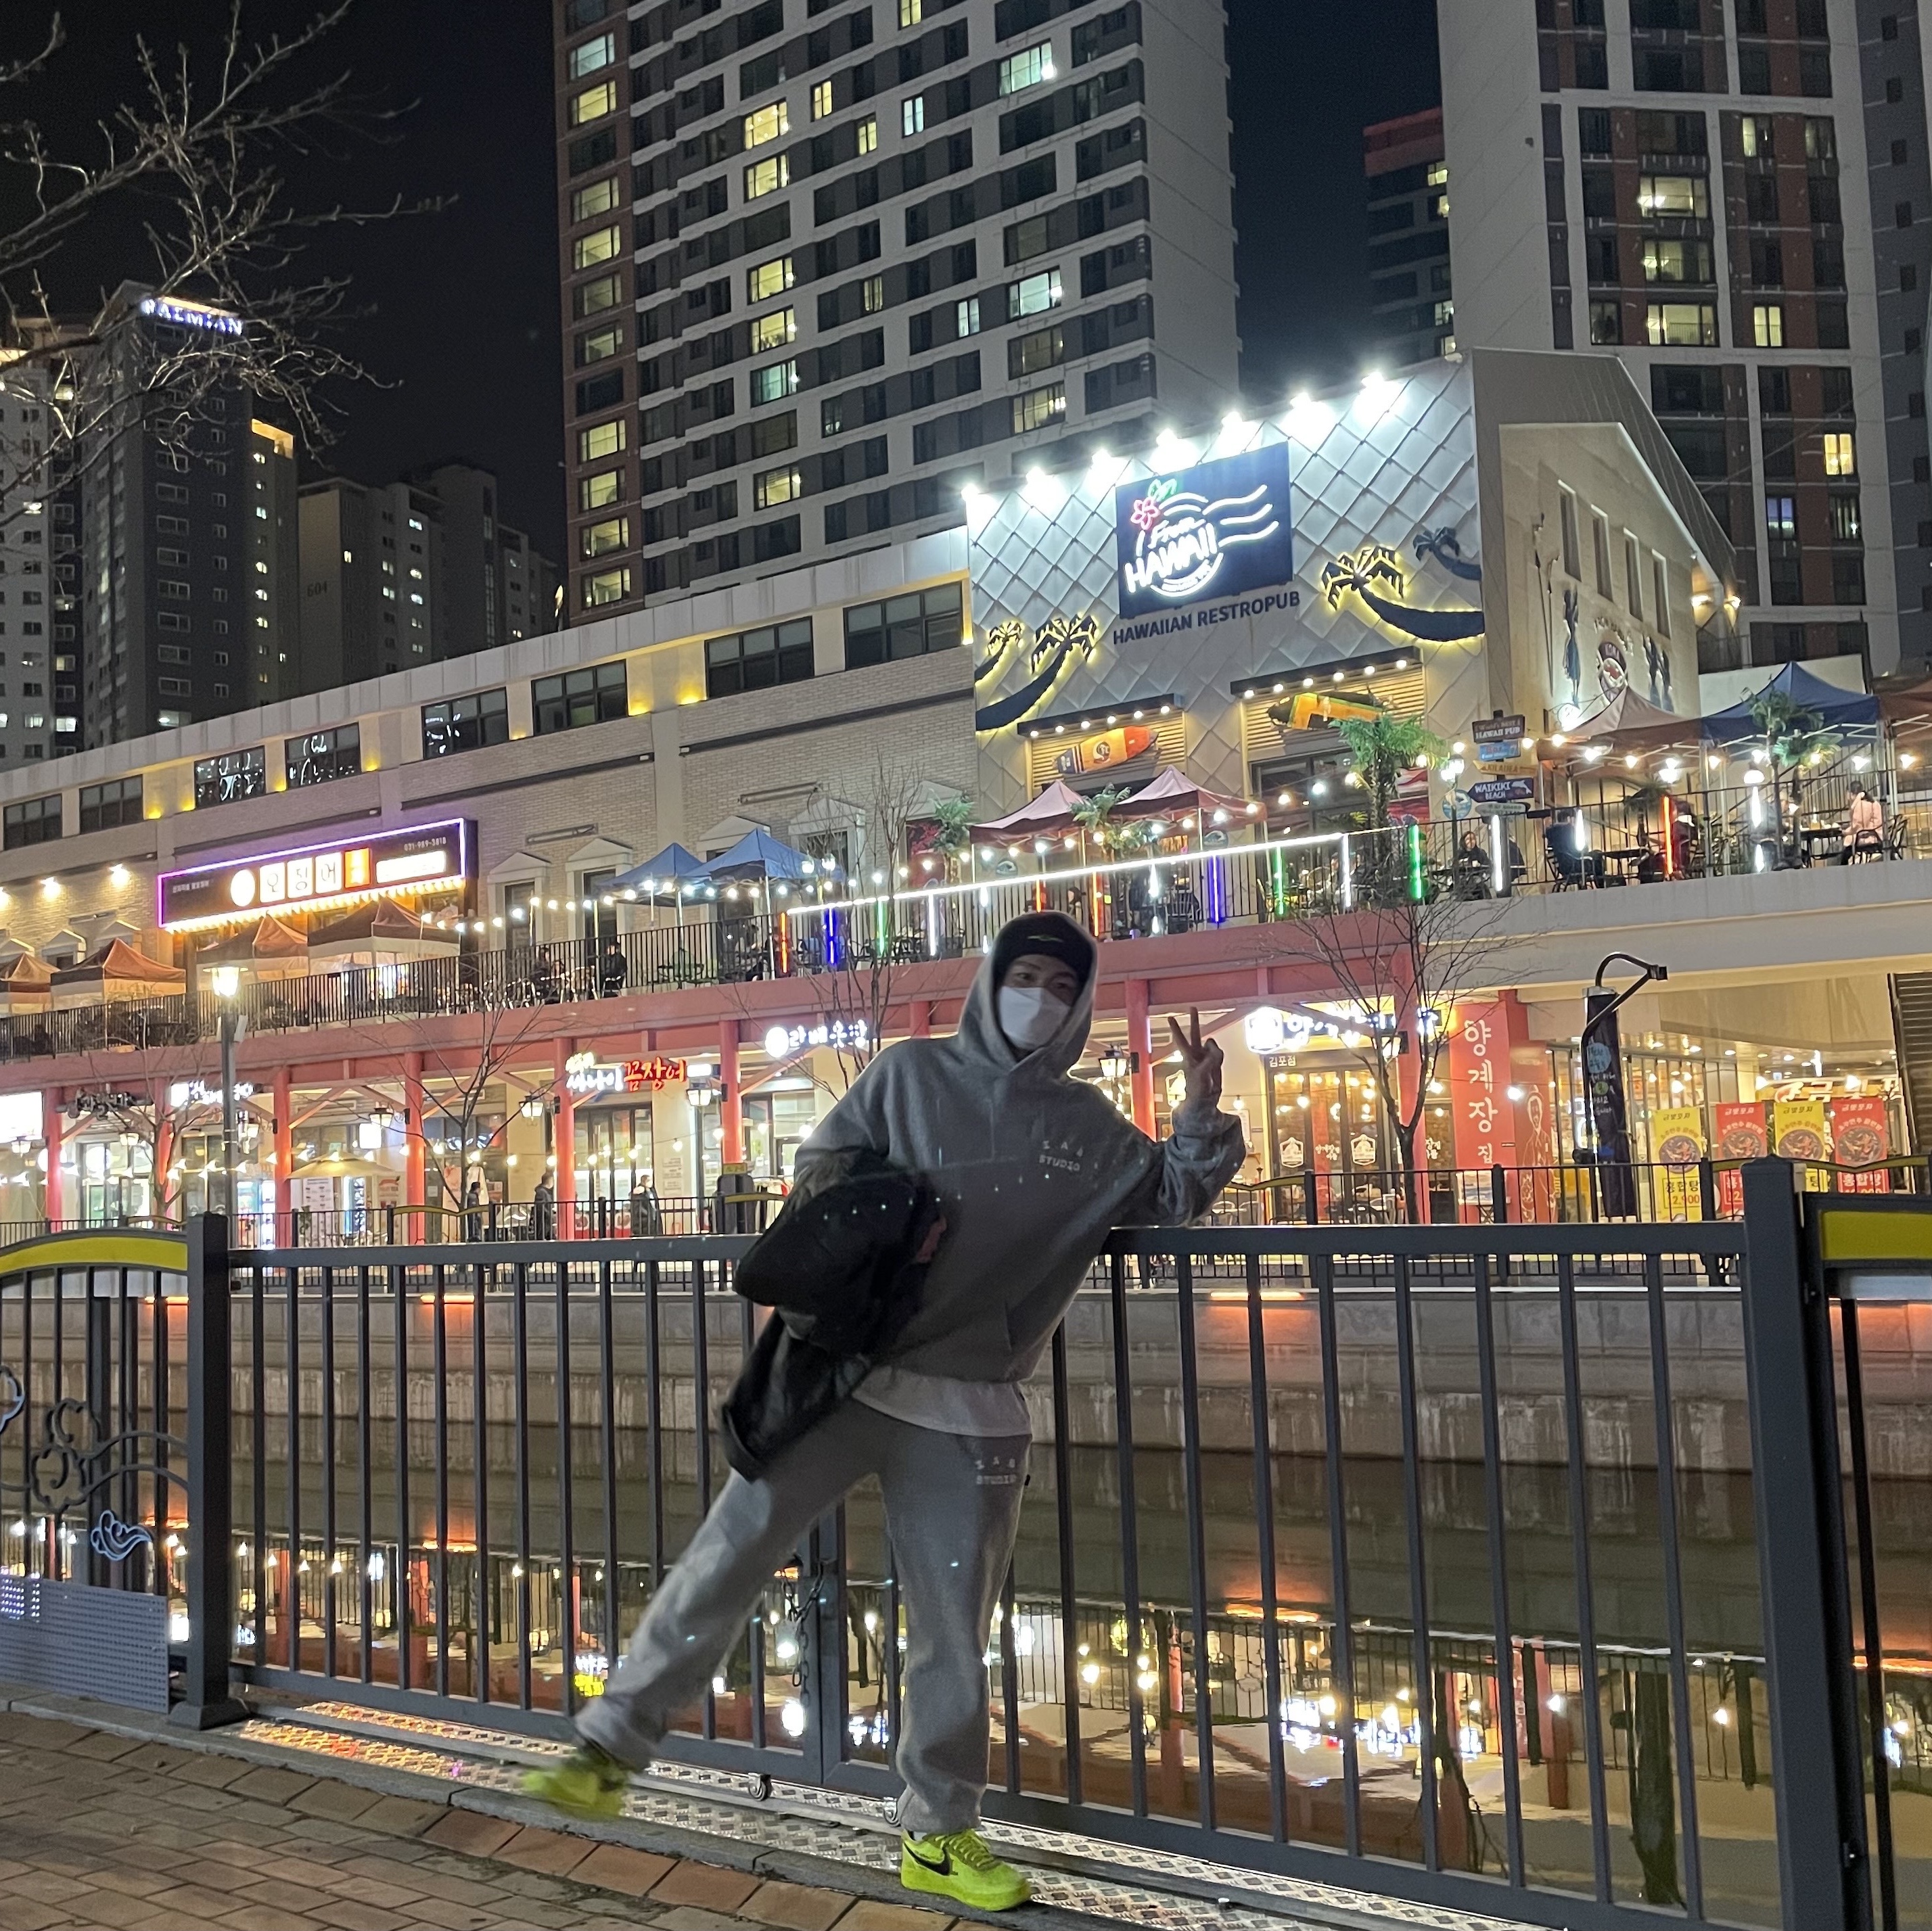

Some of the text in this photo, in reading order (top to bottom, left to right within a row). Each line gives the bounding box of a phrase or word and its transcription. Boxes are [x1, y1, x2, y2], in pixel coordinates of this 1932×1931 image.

[1124, 523, 1218, 593] HAWAII
[1113, 591, 1300, 645] HAWAIIAN RESTROPUB
[1505, 727, 1521, 735] PUB
[1475, 781, 1511, 793] WAIKIKI
[1485, 791, 1506, 799] BEACH
[1268, 1055, 1297, 1067] 김포점
[624, 1056, 687, 1092] 꼼장어
[1039, 1155, 1080, 1172] STUDIO
